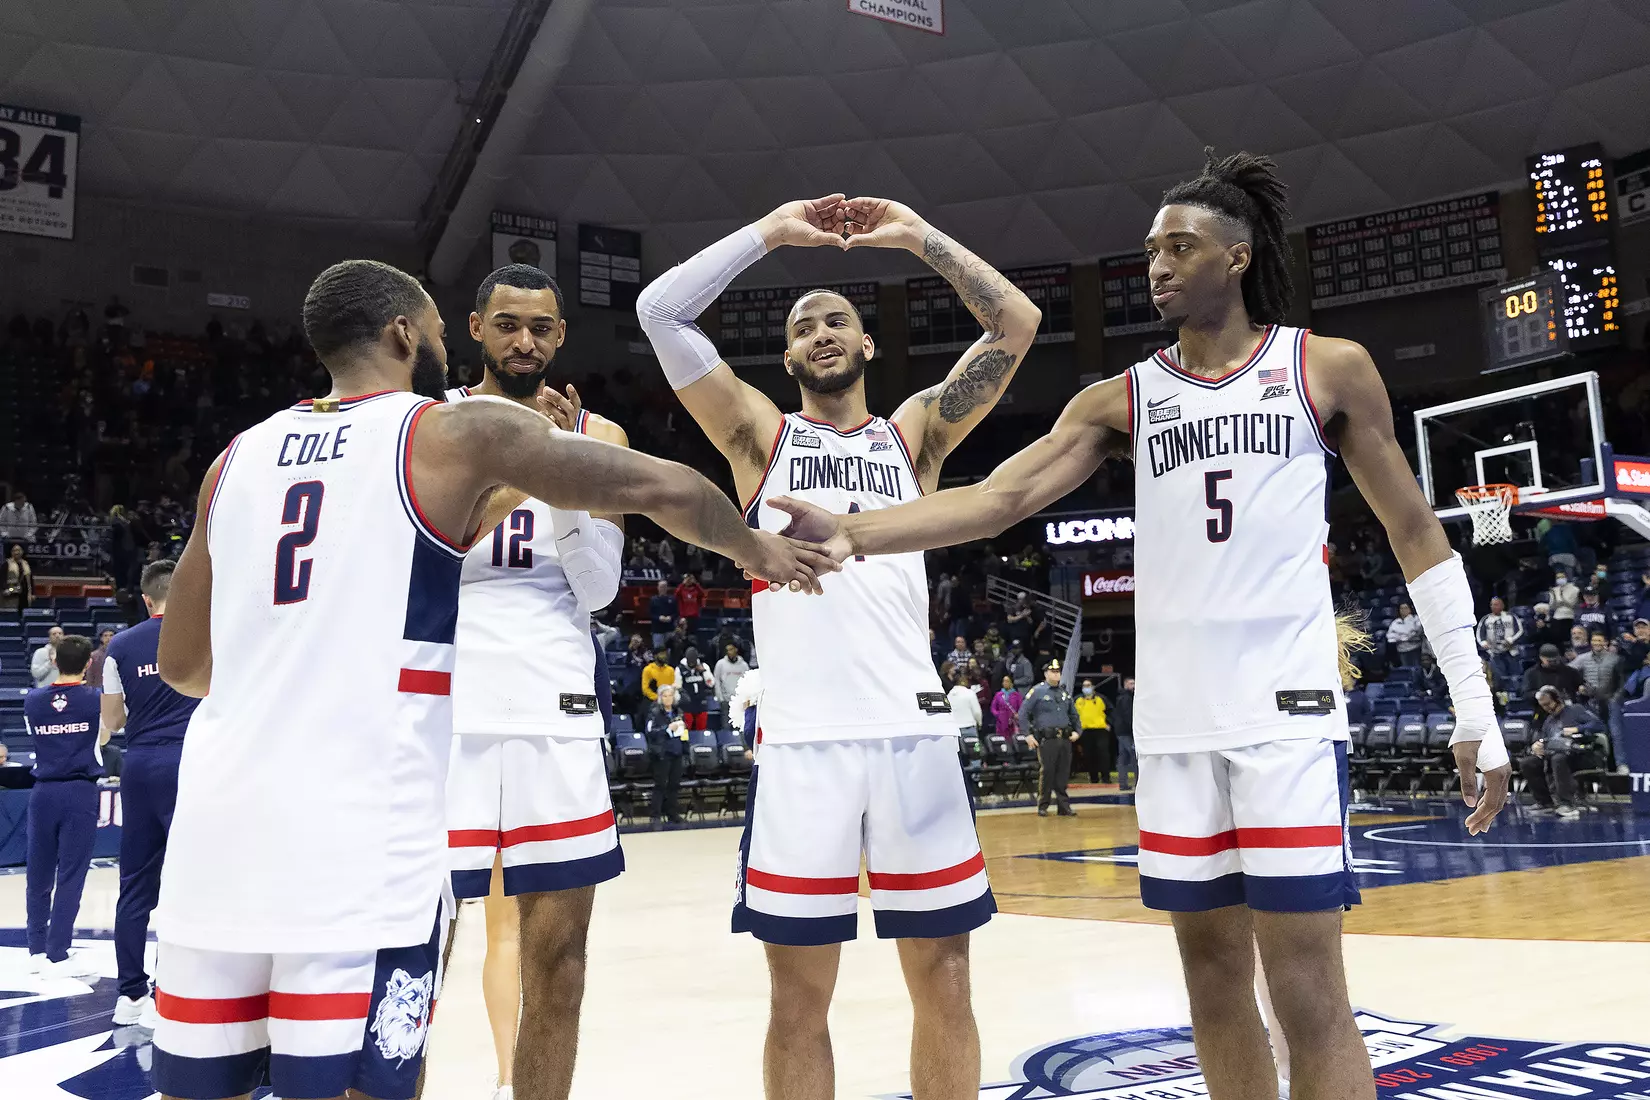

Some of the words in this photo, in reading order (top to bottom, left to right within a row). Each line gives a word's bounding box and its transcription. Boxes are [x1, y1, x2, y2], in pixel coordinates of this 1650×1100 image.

[859, 0, 933, 28] CHAMPIONS
[18, 110, 57, 128] ALLEN
[1316, 220, 1358, 238] NCAA
[1364, 195, 1488, 228] CHAMPIONSHIP
[1262, 389, 1292, 398] EAST
[1265, 384, 1286, 393] BIG
[277, 424, 352, 467] COLE
[1147, 413, 1295, 479] CONNECTICUT
[789, 455, 902, 501] CONNECTICUT
[1203, 469, 1234, 544] 5
[27, 544, 50, 554] SEC
[54, 542, 91, 557] 109
[272, 479, 325, 606] 2
[491, 509, 534, 569] 12
[641, 568, 662, 580] 111
[693, 683, 699, 694] 1
[34, 722, 89, 736] HUSKIES
[1439, 1044, 1508, 1066] 1999
